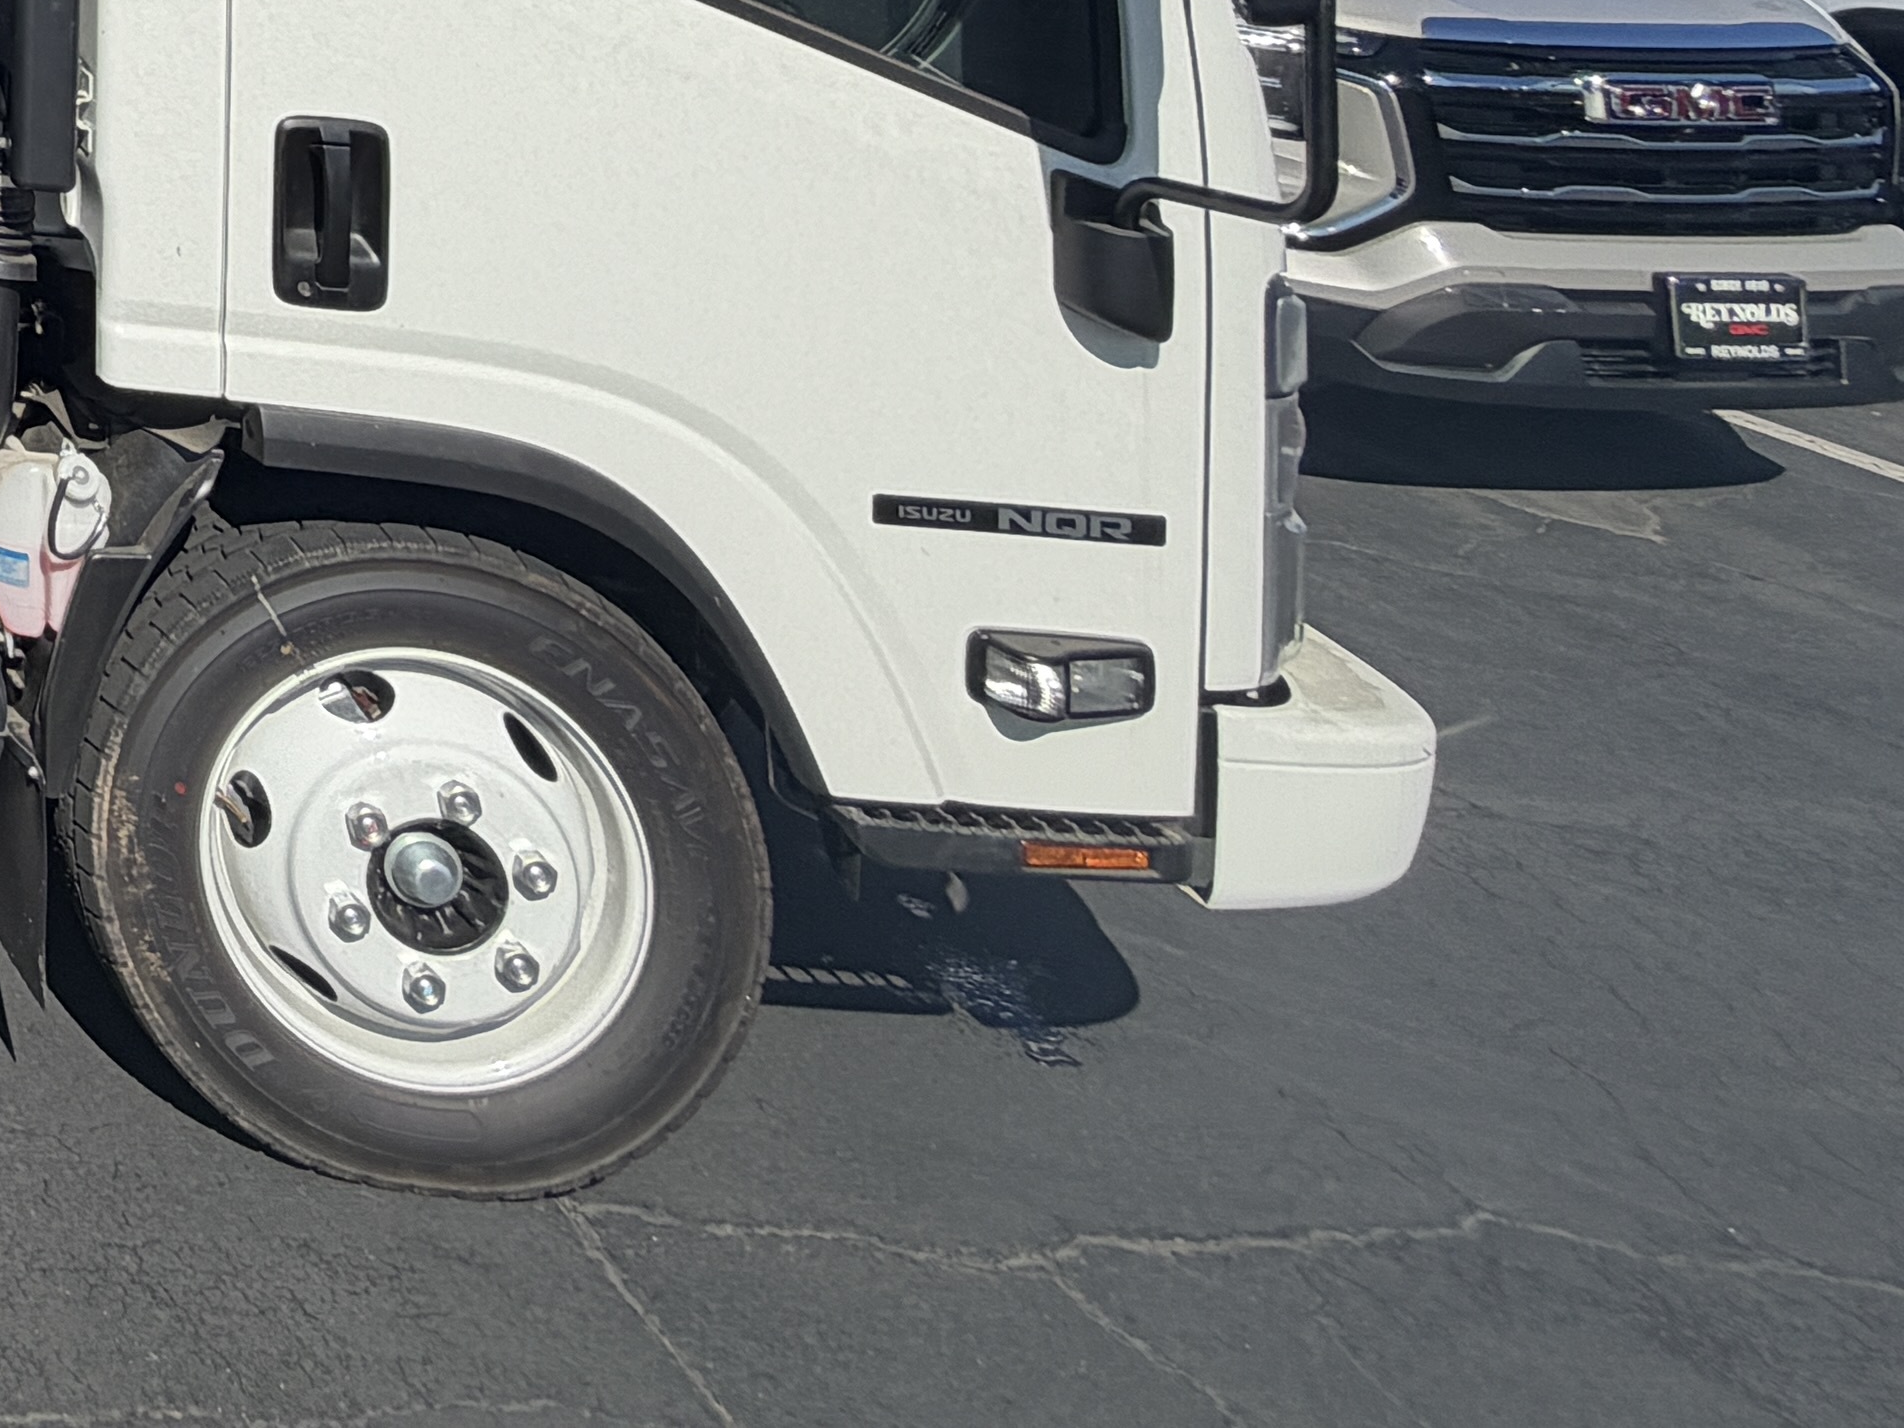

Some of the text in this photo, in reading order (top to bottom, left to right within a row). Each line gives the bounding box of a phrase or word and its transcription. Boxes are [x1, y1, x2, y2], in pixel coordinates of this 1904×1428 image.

[1610, 83, 1780, 125] GMC
[1680, 302, 1800, 329] REYNOLDS
[898, 504, 1133, 541] ISUZU NQR
